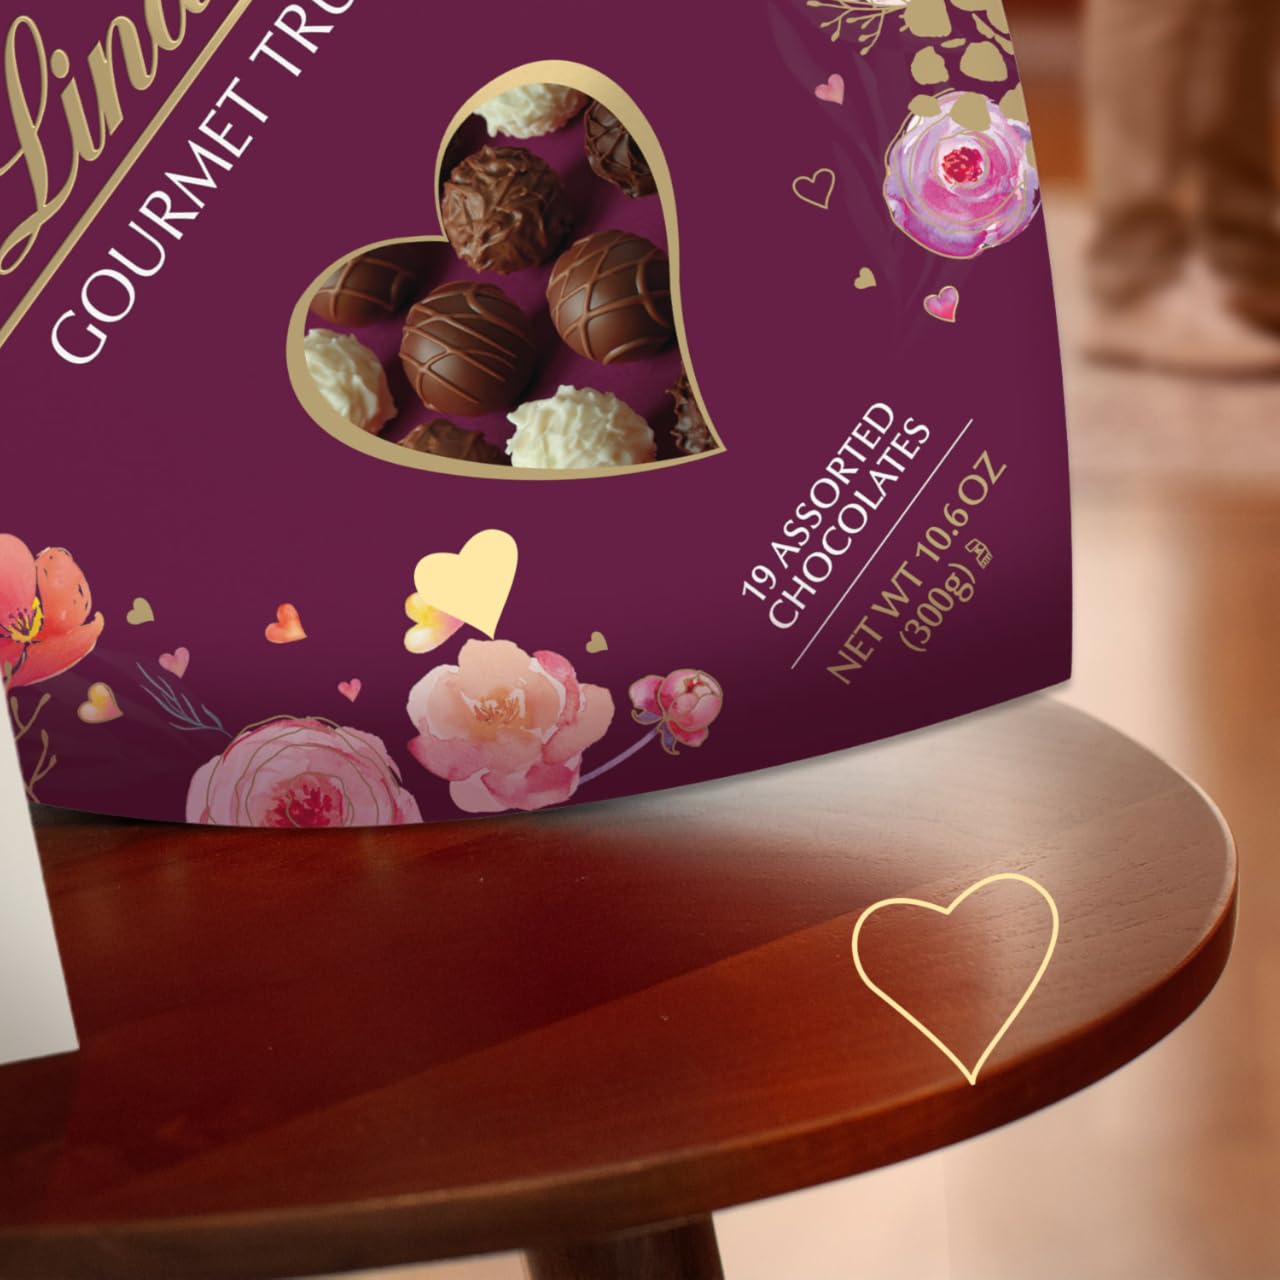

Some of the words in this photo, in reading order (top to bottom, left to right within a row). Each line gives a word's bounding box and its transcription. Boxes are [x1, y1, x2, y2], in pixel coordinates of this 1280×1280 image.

[50, 76, 269, 365] GOURMET
[741, 564, 777, 601] 19
[771, 402, 895, 569] ASSORTED
[768, 417, 930, 629] CHOCOLATES
[826, 615, 883, 685] NET
[871, 560, 923, 618] WT
[916, 503, 969, 562] 10.6
[957, 450, 1007, 506] OZ
[899, 563, 976, 652] (300g)
